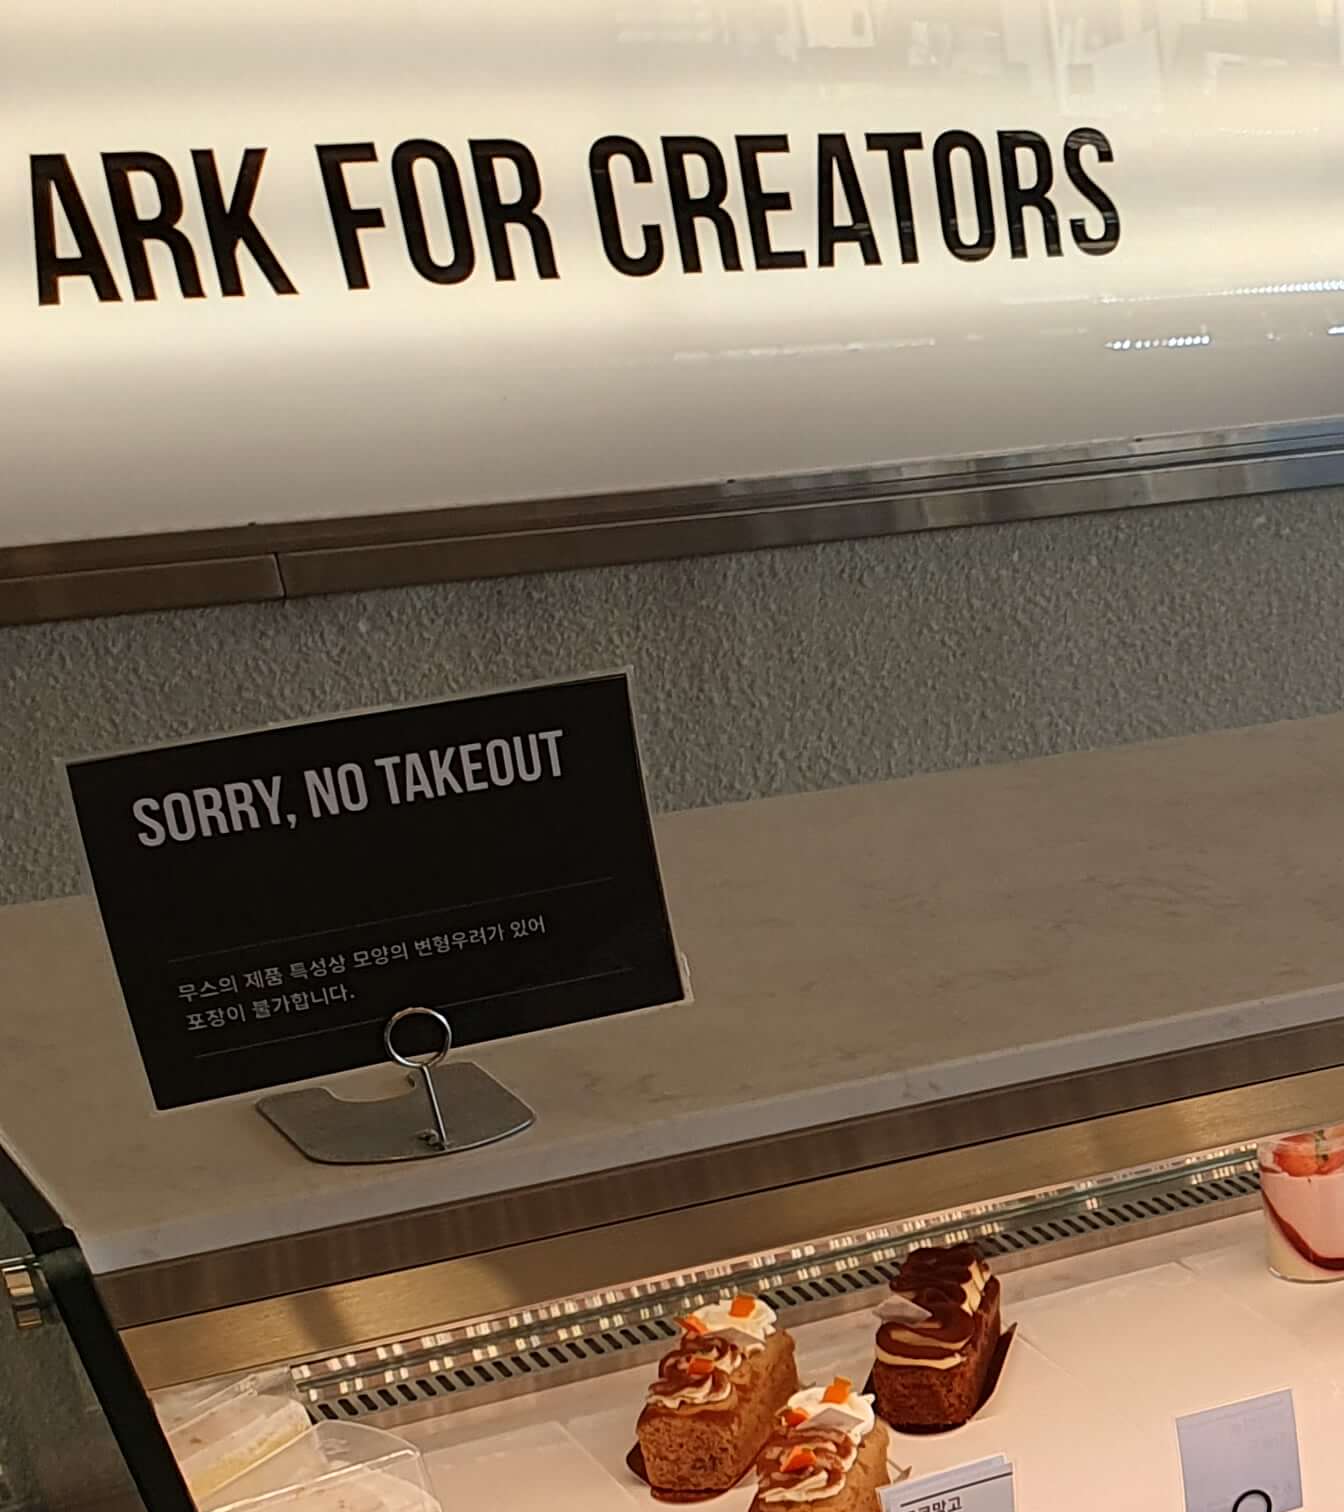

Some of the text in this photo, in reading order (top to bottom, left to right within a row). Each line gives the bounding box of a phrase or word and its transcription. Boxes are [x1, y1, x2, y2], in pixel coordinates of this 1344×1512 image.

[29, 127, 1122, 307] ARK FOR CREATORS
[132, 729, 565, 847] SORRY, NO TAKEOUT
[178, 975, 238, 1002] 무스의
[242, 967, 283, 989] 제품
[289, 954, 346, 980] 특성상
[353, 942, 409, 968] 모양의
[510, 914, 546, 939] 있어
[185, 983, 356, 1031] 포장이 불가합니다.
